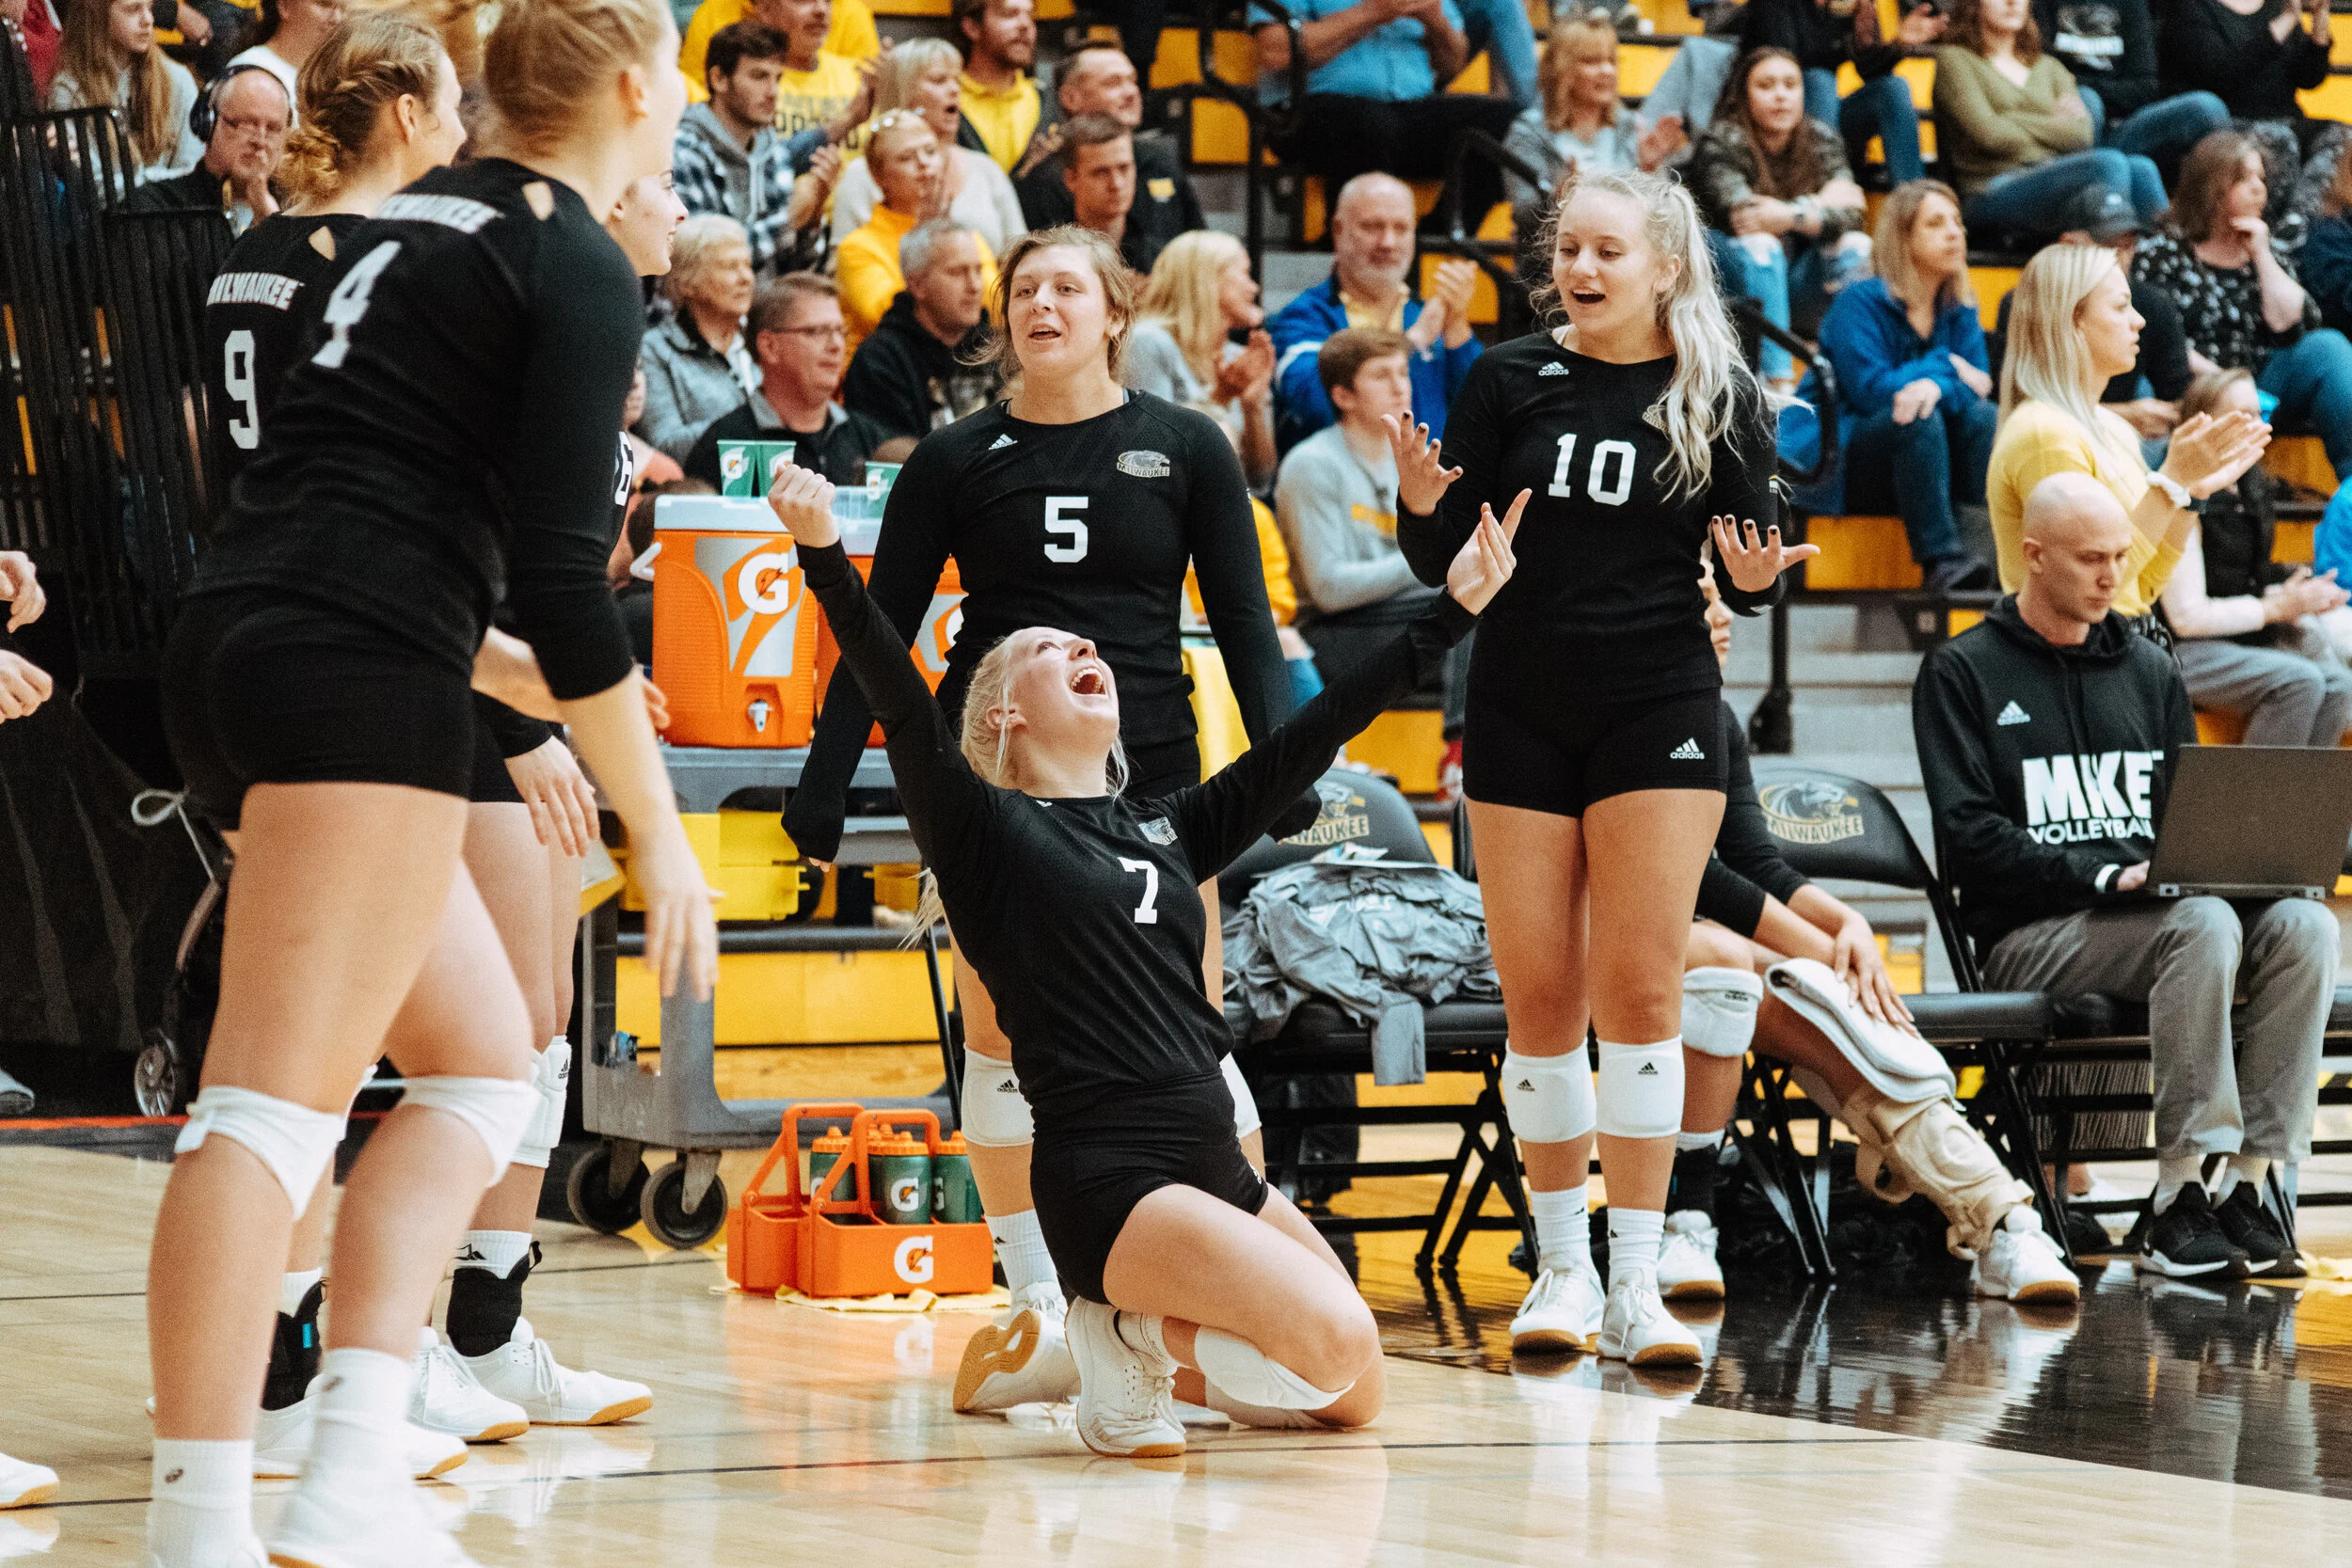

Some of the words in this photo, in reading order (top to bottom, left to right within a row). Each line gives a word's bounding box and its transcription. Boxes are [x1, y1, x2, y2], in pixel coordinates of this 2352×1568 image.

[311, 241, 402, 368] 4
[224, 329, 260, 450] 9
[614, 431, 633, 506] 6
[722, 452, 743, 479] G
[1118, 463, 1169, 477] MILWAUKEE
[1548, 433, 1637, 506] 10
[1044, 497, 1089, 562] 5
[739, 552, 788, 615] G
[1283, 817, 1369, 846] WAUKEE
[1118, 857, 1158, 924] 7
[890, 1177, 919, 1212] G
[894, 1235, 934, 1284] G
